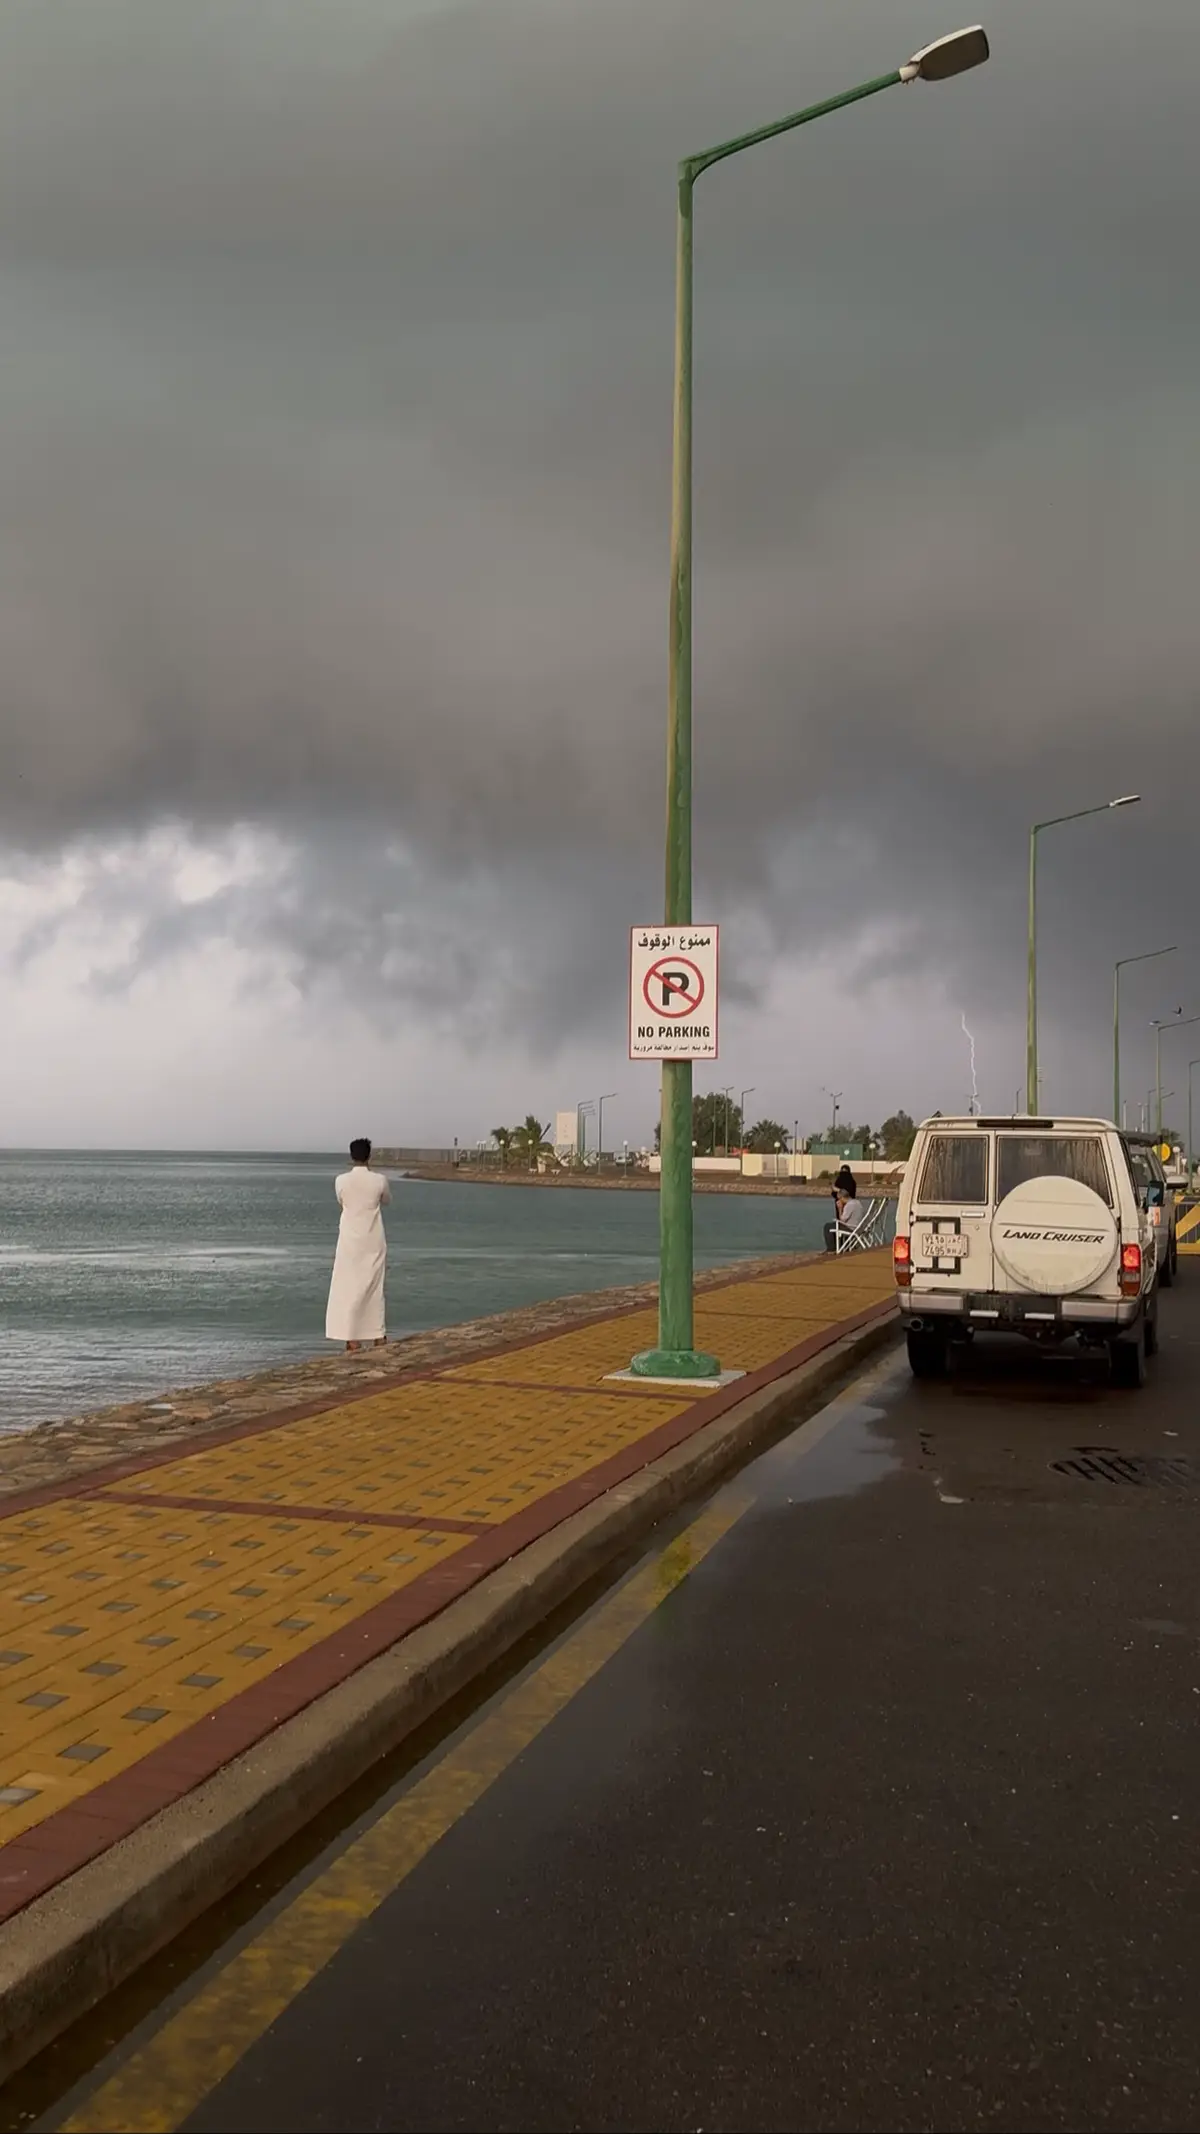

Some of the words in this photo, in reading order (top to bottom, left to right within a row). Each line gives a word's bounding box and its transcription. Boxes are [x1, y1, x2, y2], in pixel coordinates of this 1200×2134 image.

[638, 933, 675, 951] الوقوف
[679, 933, 711, 951] ممنوع
[662, 972, 690, 1006] P
[637, 1026, 654, 1038] NO
[658, 1026, 710, 1038] PARKING
[1002, 1230, 1042, 1240] LAND
[1042, 1231, 1105, 1244] CRUISER
